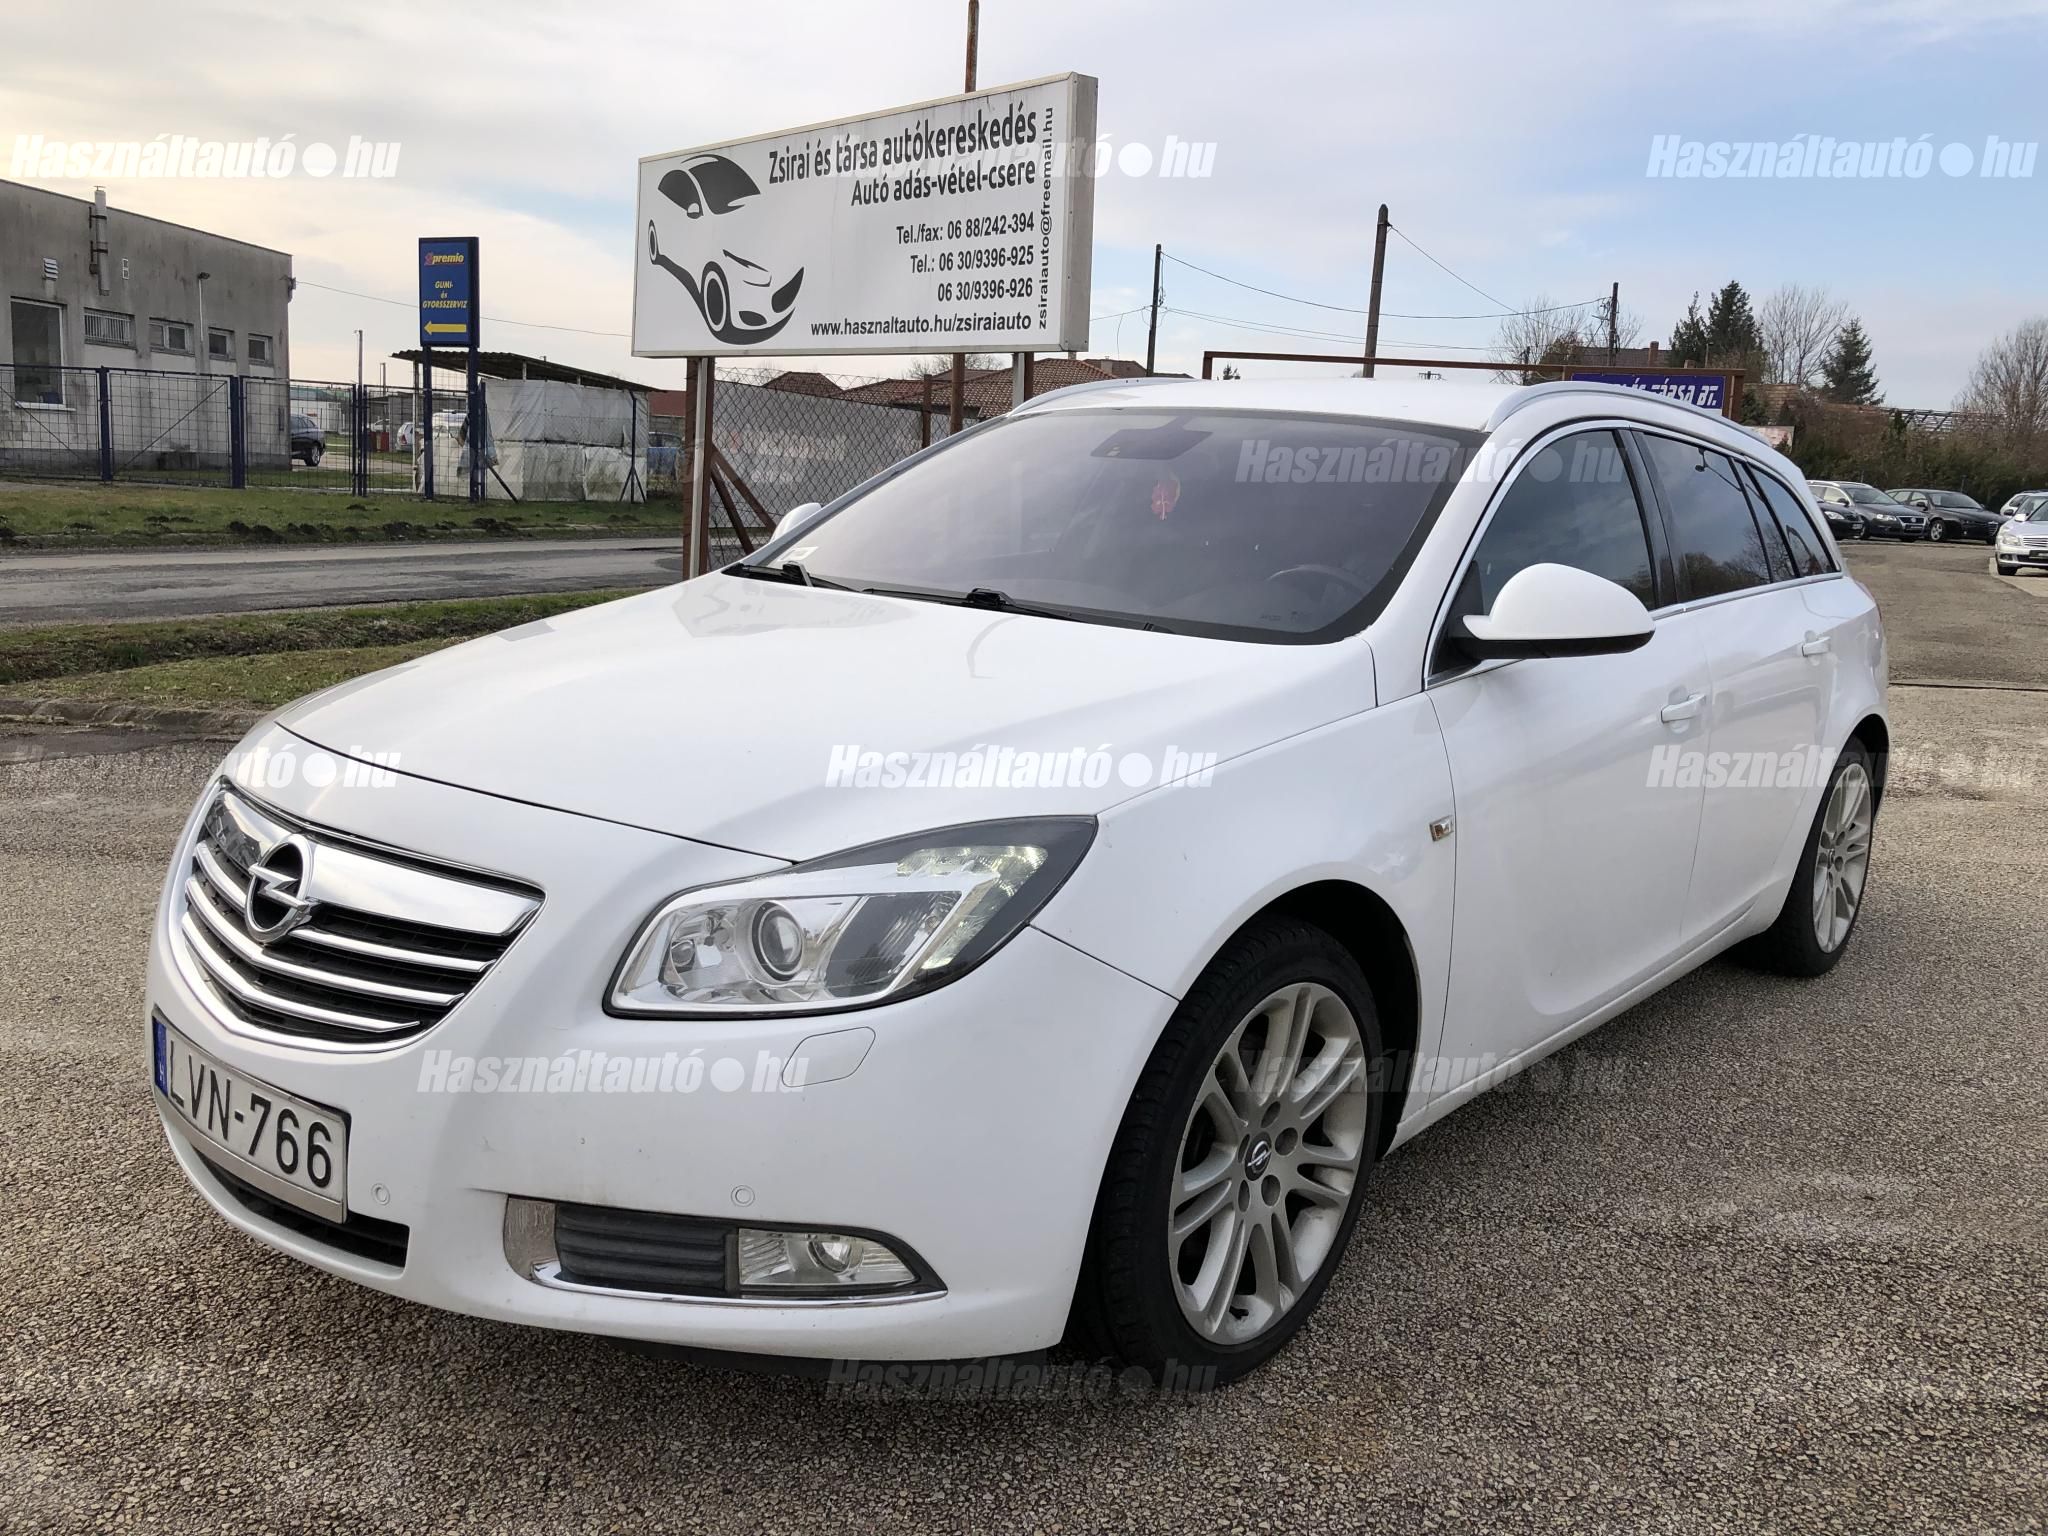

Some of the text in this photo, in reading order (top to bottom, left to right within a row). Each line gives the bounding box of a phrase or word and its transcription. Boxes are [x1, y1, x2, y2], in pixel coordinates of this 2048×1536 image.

[769, 100, 1037, 184] Zsirai és társa autókereskedés
[851, 159, 1036, 206] Autó adás-vétel-csere
[896, 211, 1034, 244] Tel./fax: 06 88/242-394
[1038, 107, 1053, 330] zsiraiauto@freemail.hu
[910, 245, 1034, 273] Tel.: 06 30/9396-925
[938, 277, 1033, 302] 06 30/9396-926
[810, 312, 1032, 336] www.hasznaltauto.hu/zsiraiauto
[169, 1040, 333, 1189] LVN-766
